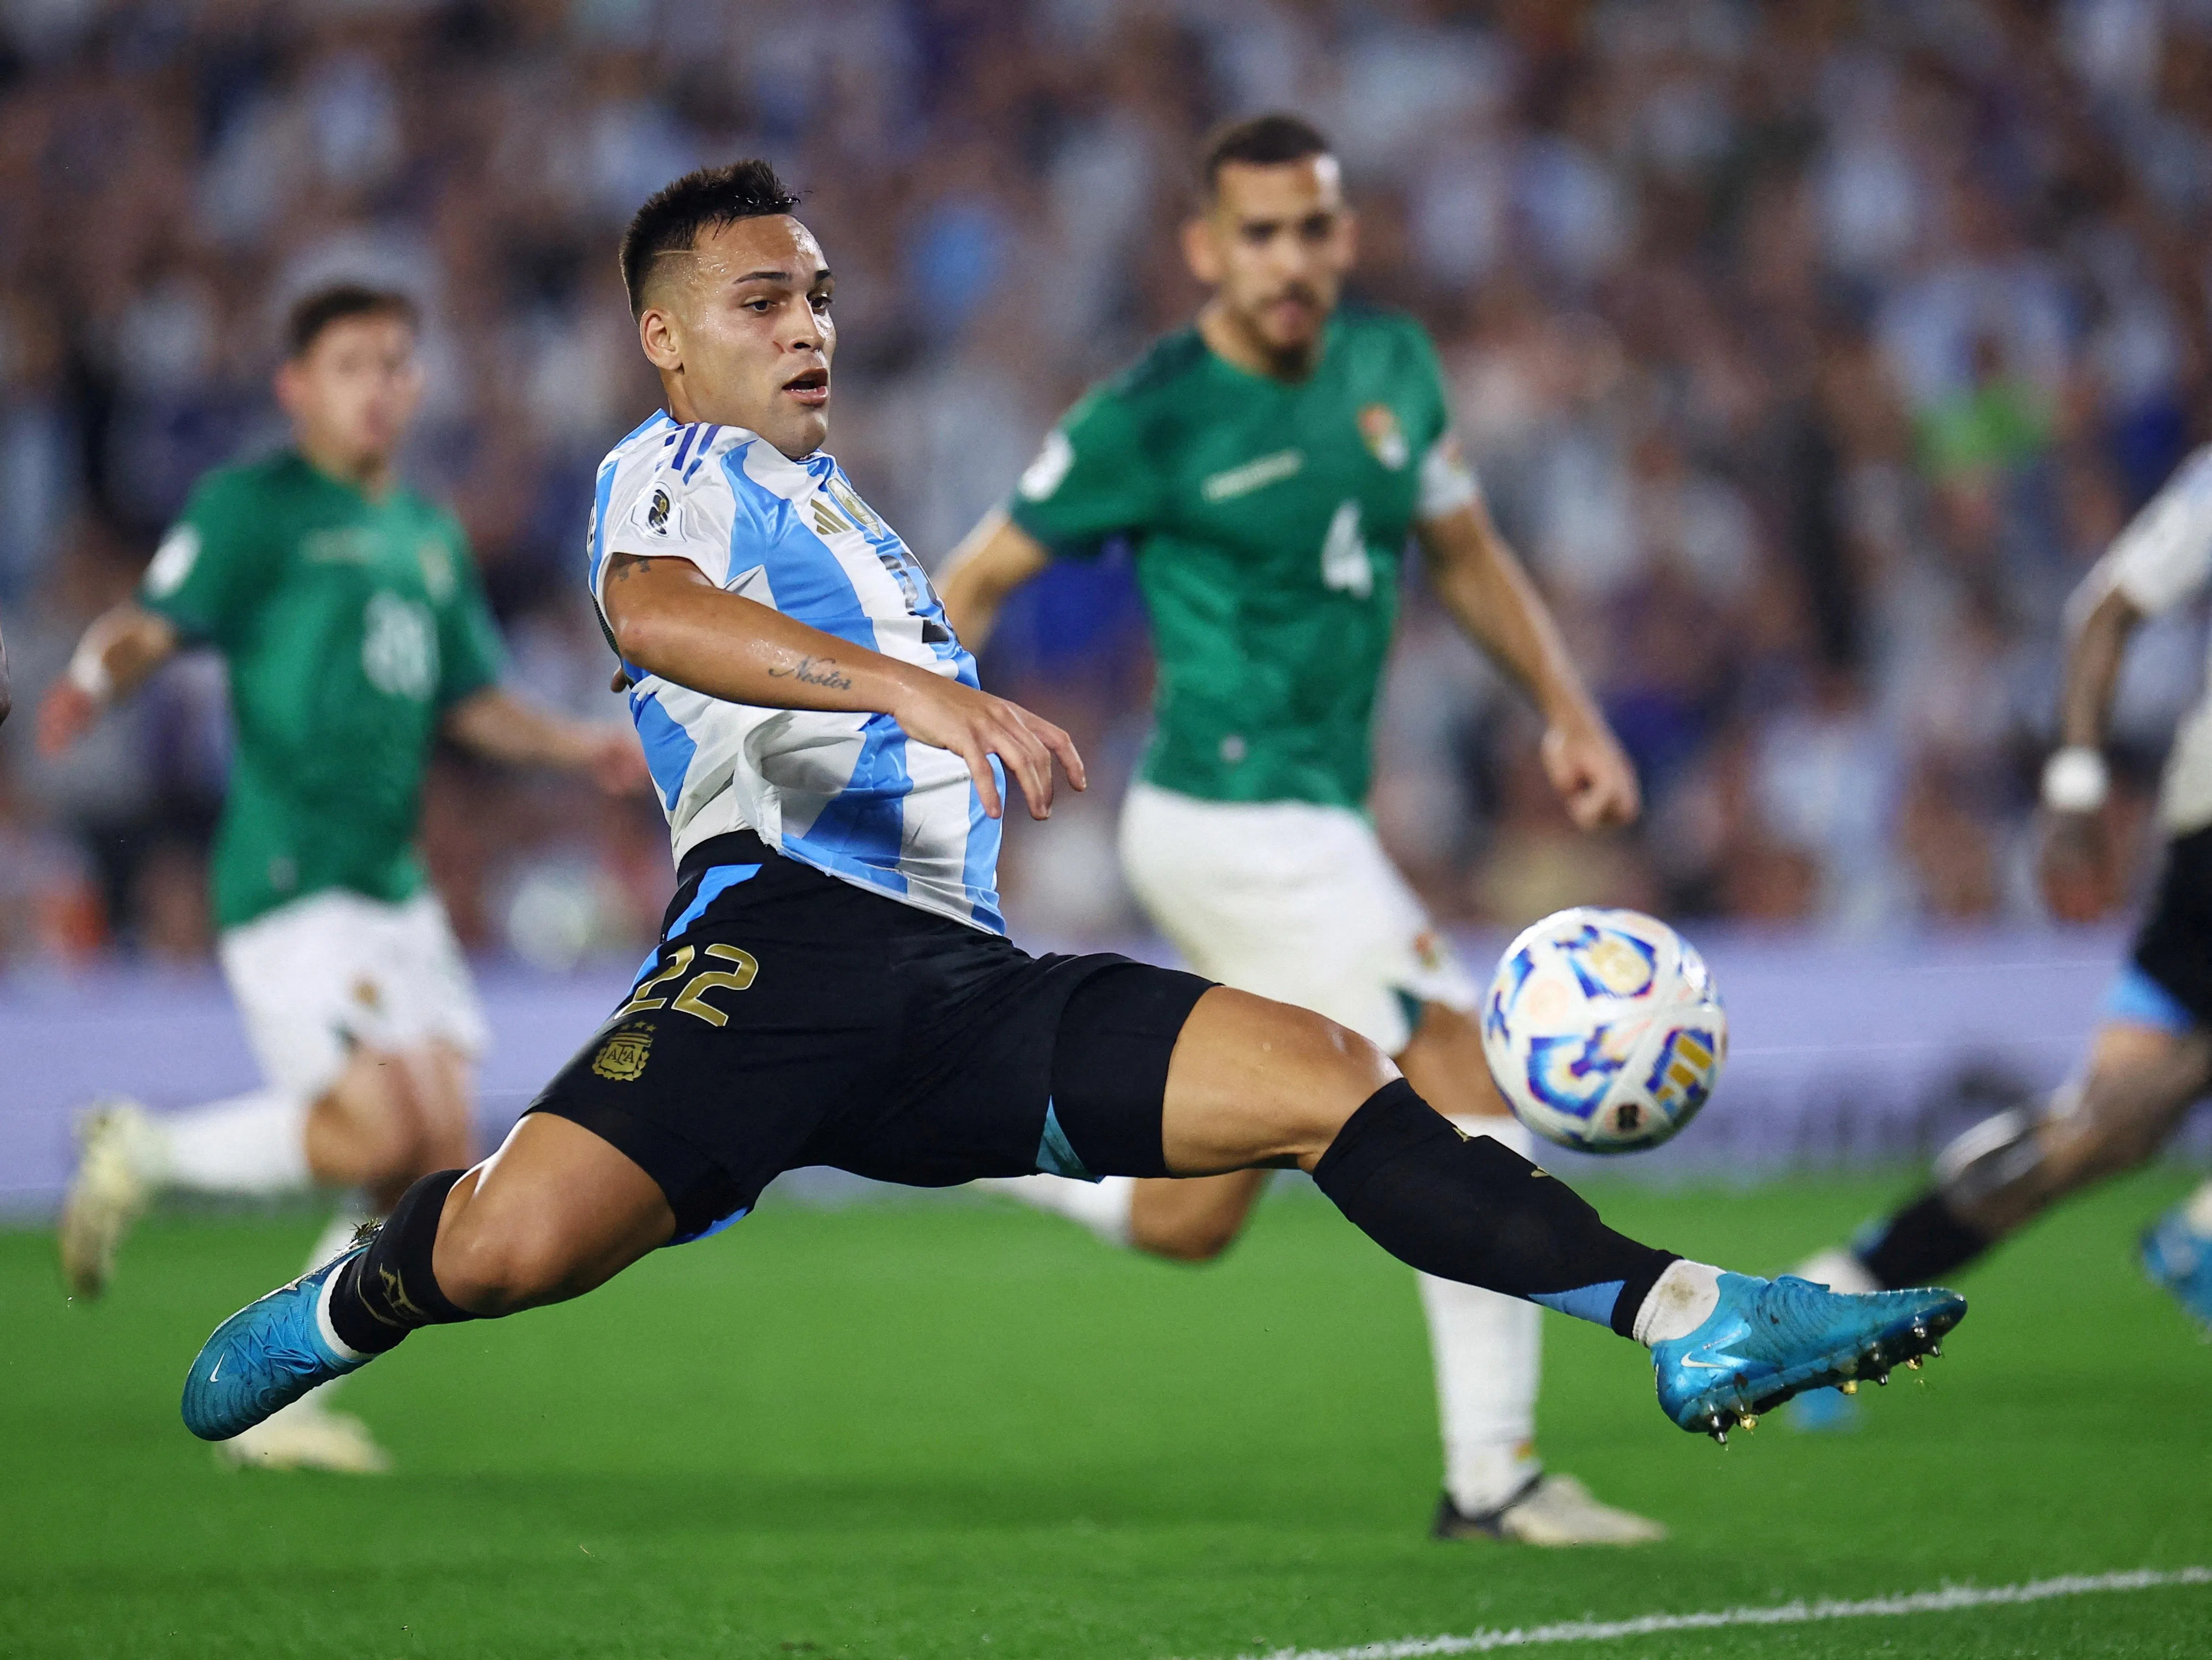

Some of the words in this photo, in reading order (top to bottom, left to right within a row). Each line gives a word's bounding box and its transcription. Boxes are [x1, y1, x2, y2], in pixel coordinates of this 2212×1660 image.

[1322, 499, 1373, 599] 4
[614, 943, 759, 1027] 22
[606, 1043, 635, 1066] AFA
